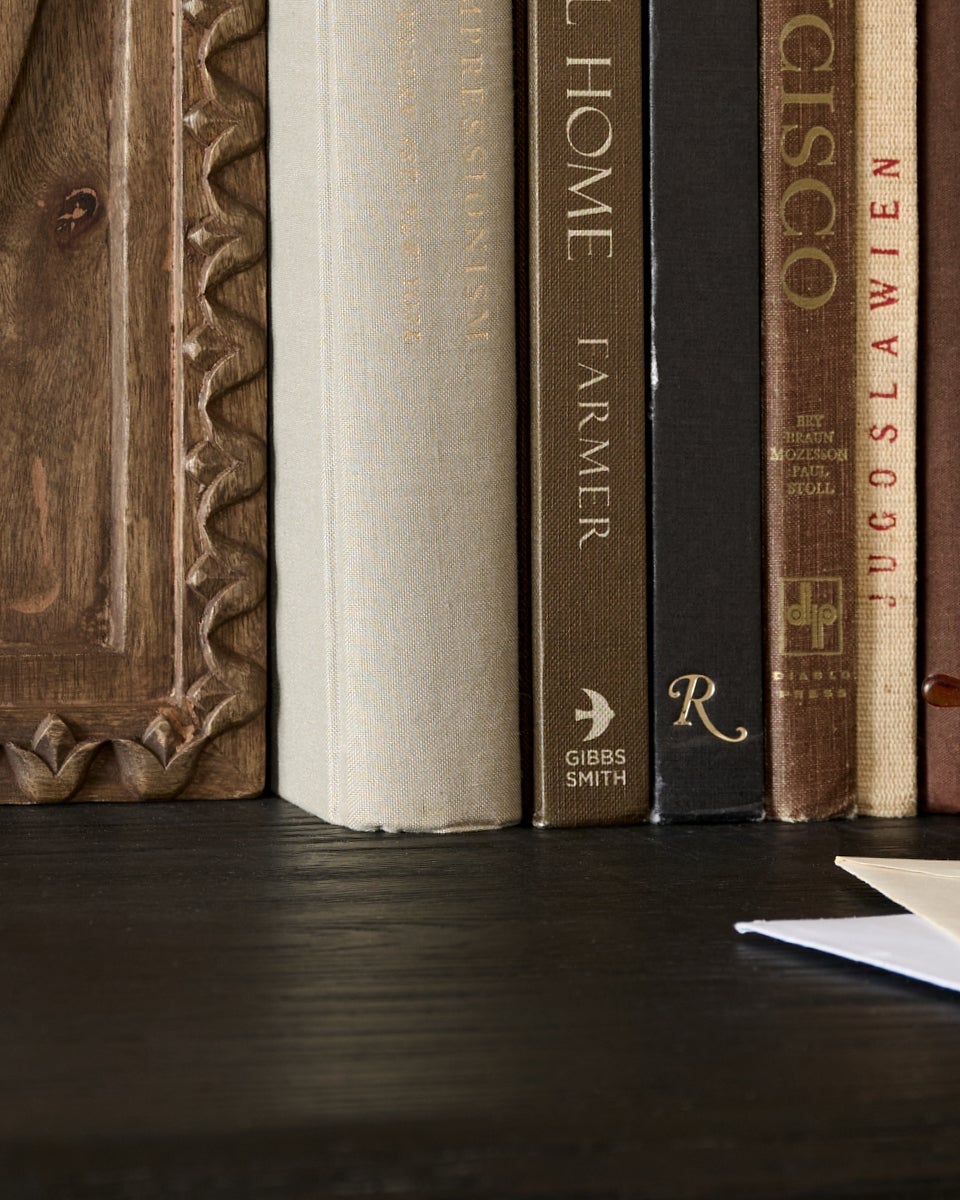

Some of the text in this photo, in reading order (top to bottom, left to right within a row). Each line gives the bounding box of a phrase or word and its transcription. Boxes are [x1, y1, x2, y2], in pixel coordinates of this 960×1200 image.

[566, 56, 613, 261] HOME
[868, 158, 901, 608] JUGOSLAWIEN
[577, 337, 610, 550] FARMER
[786, 431, 834, 444] BRAUN
[792, 465, 829, 478] PAUL
[787, 482, 836, 495] STOLL
[668, 673, 748, 743] R
[565, 749, 626, 766] GIBBS
[565, 770, 626, 788] SMITH
